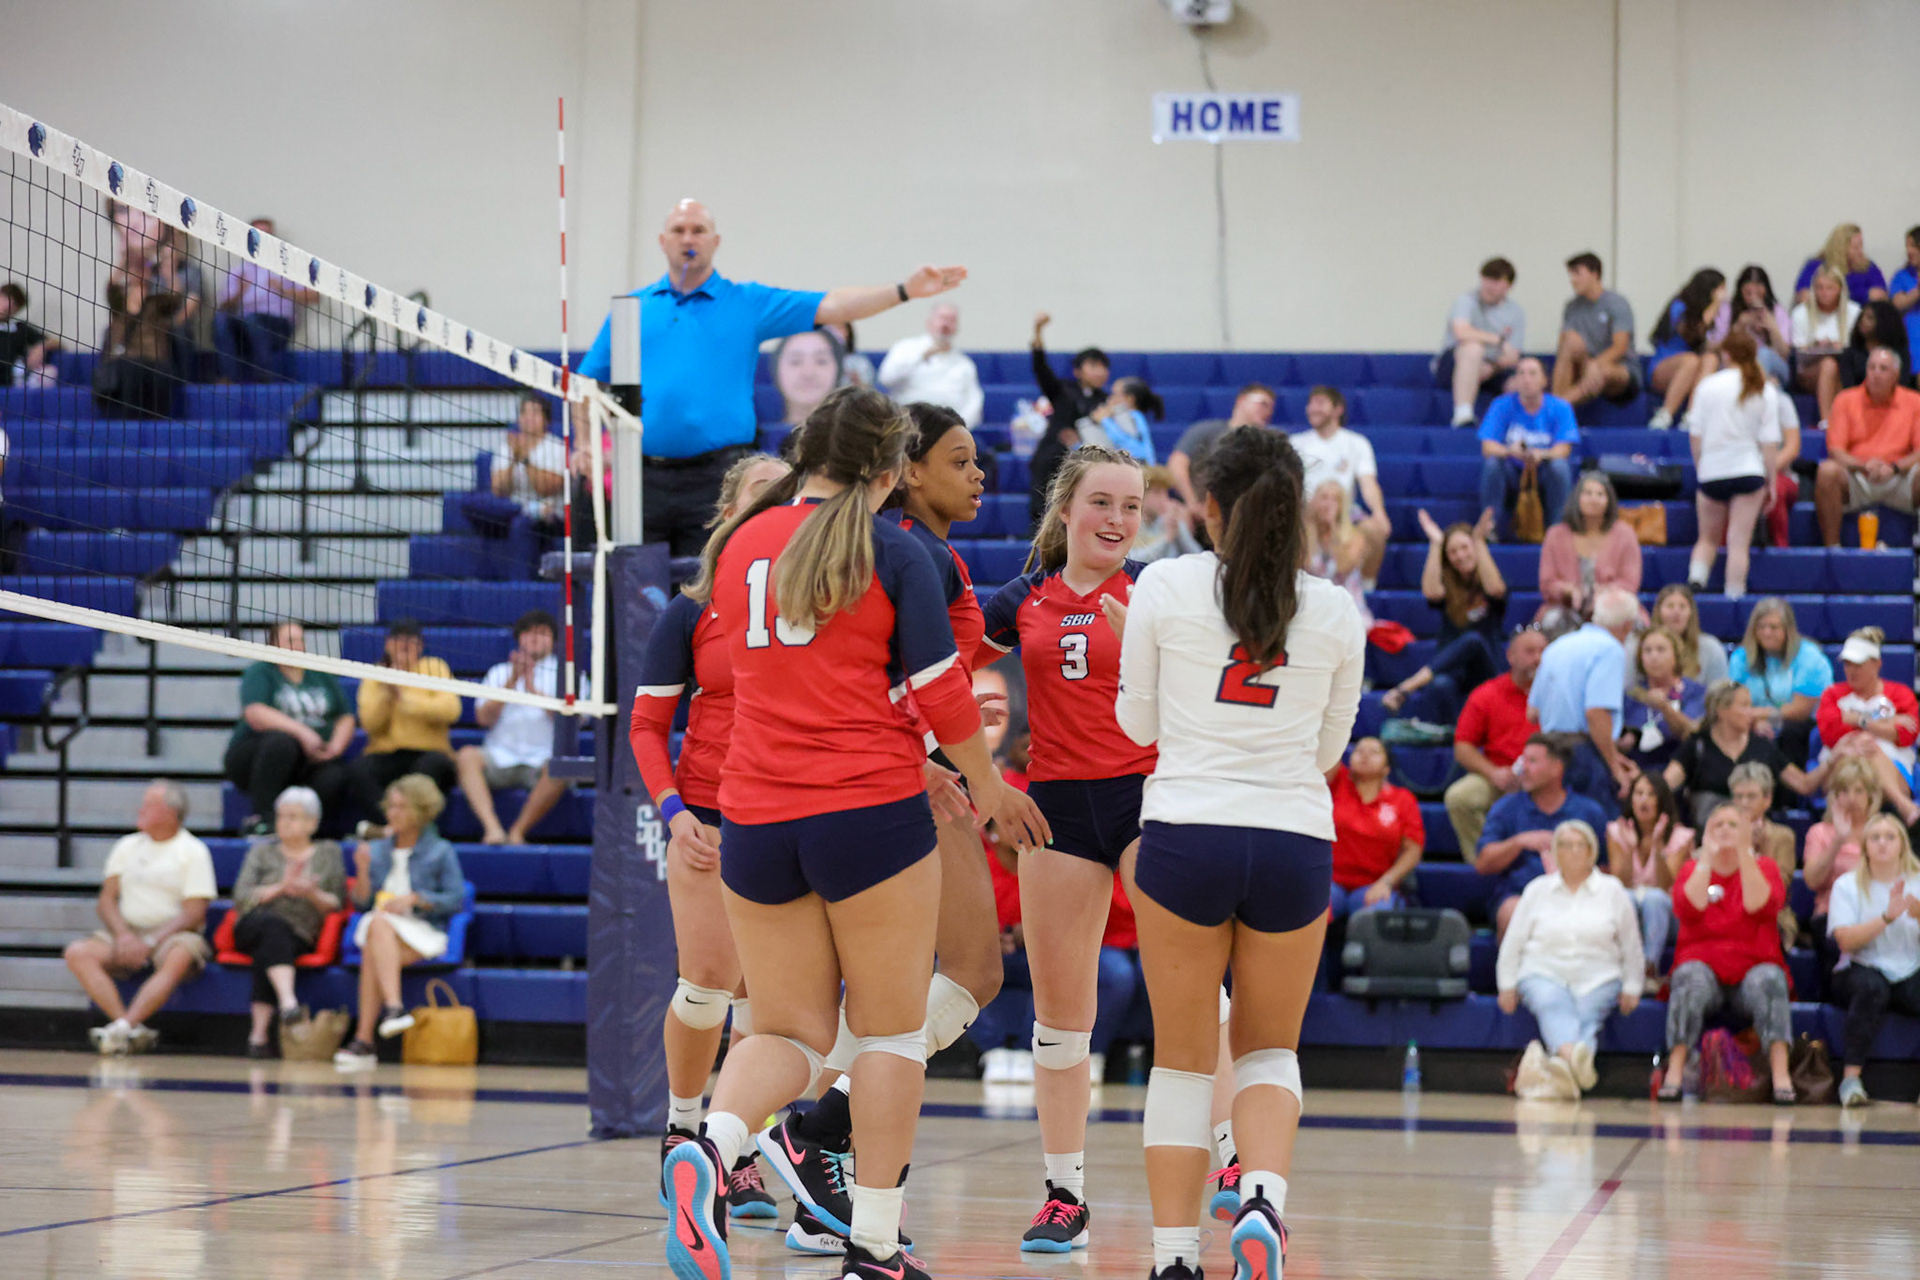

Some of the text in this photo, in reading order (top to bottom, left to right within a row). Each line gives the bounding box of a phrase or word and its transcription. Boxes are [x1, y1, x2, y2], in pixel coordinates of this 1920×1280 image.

[1172, 100, 1281, 132] HOME
[1060, 612, 1096, 627] SBA
[1058, 632, 1089, 681] 3
[1215, 641, 1288, 709] 2
